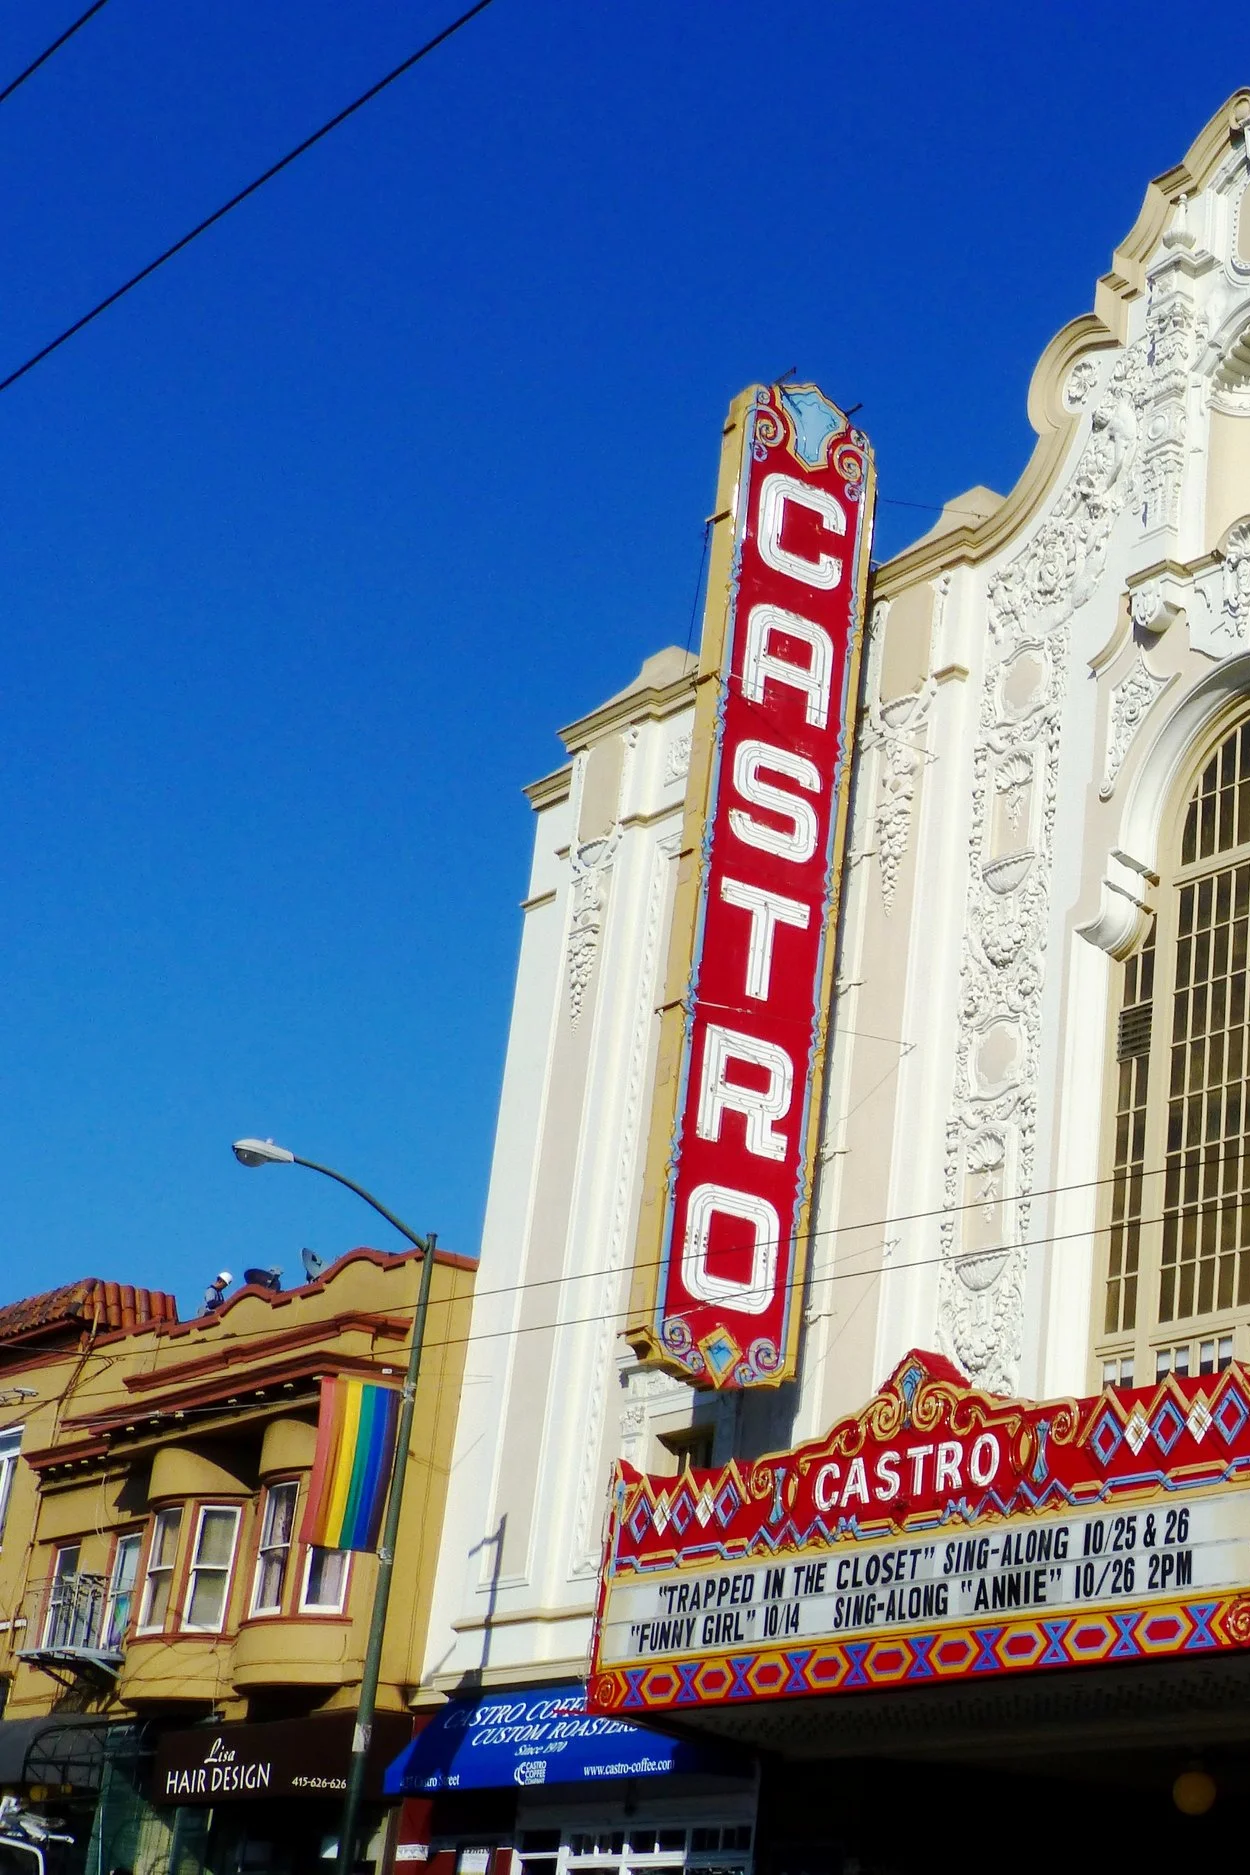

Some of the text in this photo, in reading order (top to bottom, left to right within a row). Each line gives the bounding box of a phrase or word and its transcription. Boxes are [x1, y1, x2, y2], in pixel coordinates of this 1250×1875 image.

[681, 472, 847, 1315] CASTRO
[813, 1432, 1000, 1512] CASTRO
[658, 1508, 1190, 1614] "TRAPPED IN THE CLOSET" SING-ALONG 10/25 & 26
[631, 1550, 1193, 1652] "FUNNY GIRL" 10/14 SING-ALONG "ANNIE" 10/26 2PM
[444, 1702, 528, 1729] CASTRO
[472, 1722, 551, 1747] CUSTOM
[166, 1762, 271, 1794] HAIR DESIGN
[204, 1737, 236, 1763] Lisa
